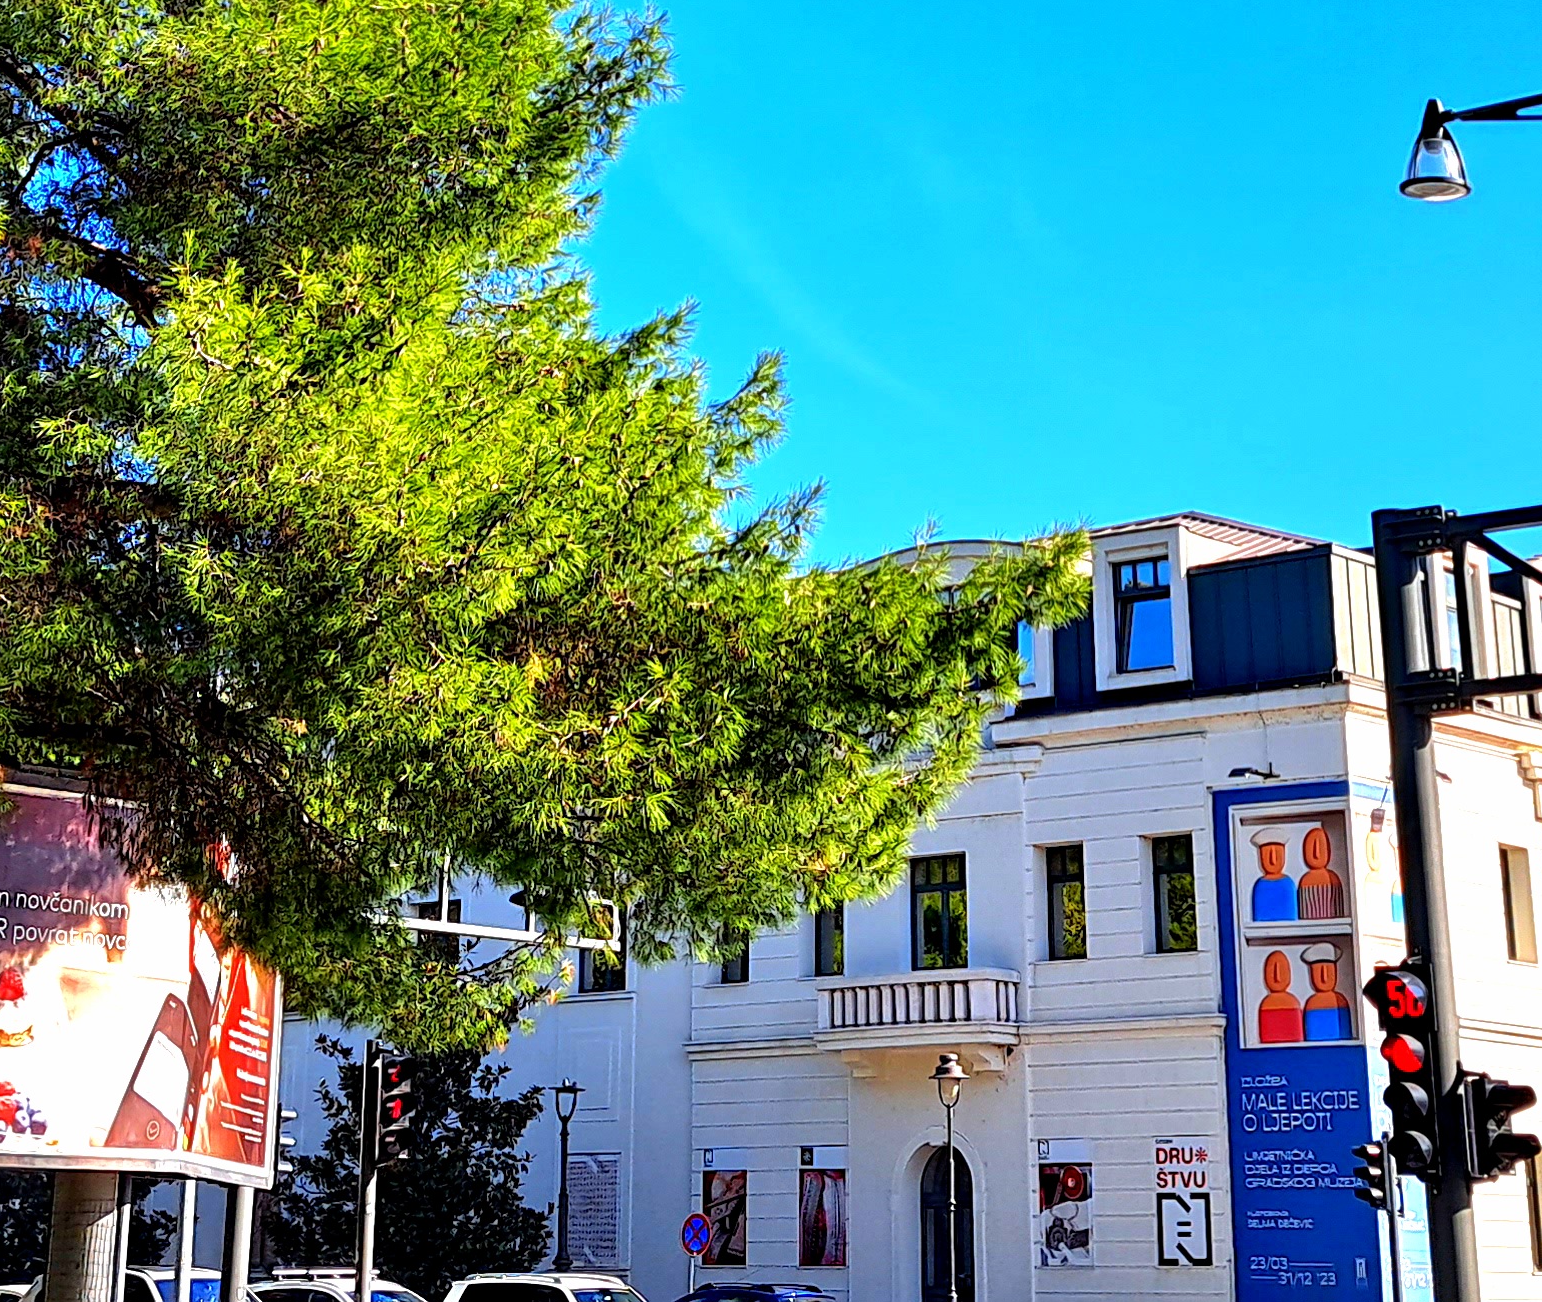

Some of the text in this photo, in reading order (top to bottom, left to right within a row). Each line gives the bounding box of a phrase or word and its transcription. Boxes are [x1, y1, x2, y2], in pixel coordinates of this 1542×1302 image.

[15, 891, 129, 920] novčanikom
[12, 923, 79, 946] povrat
[1242, 1091, 1360, 1111] MALE LEKCIJE
[1243, 1112, 1333, 1131] O LJEPOTI
[1156, 1167, 1207, 1189] ŠTVU
[1245, 1177, 1316, 1189] GRADSKOG
[1250, 1256, 1288, 1271] 23/03
[1278, 1271, 1312, 1287] 31/12
